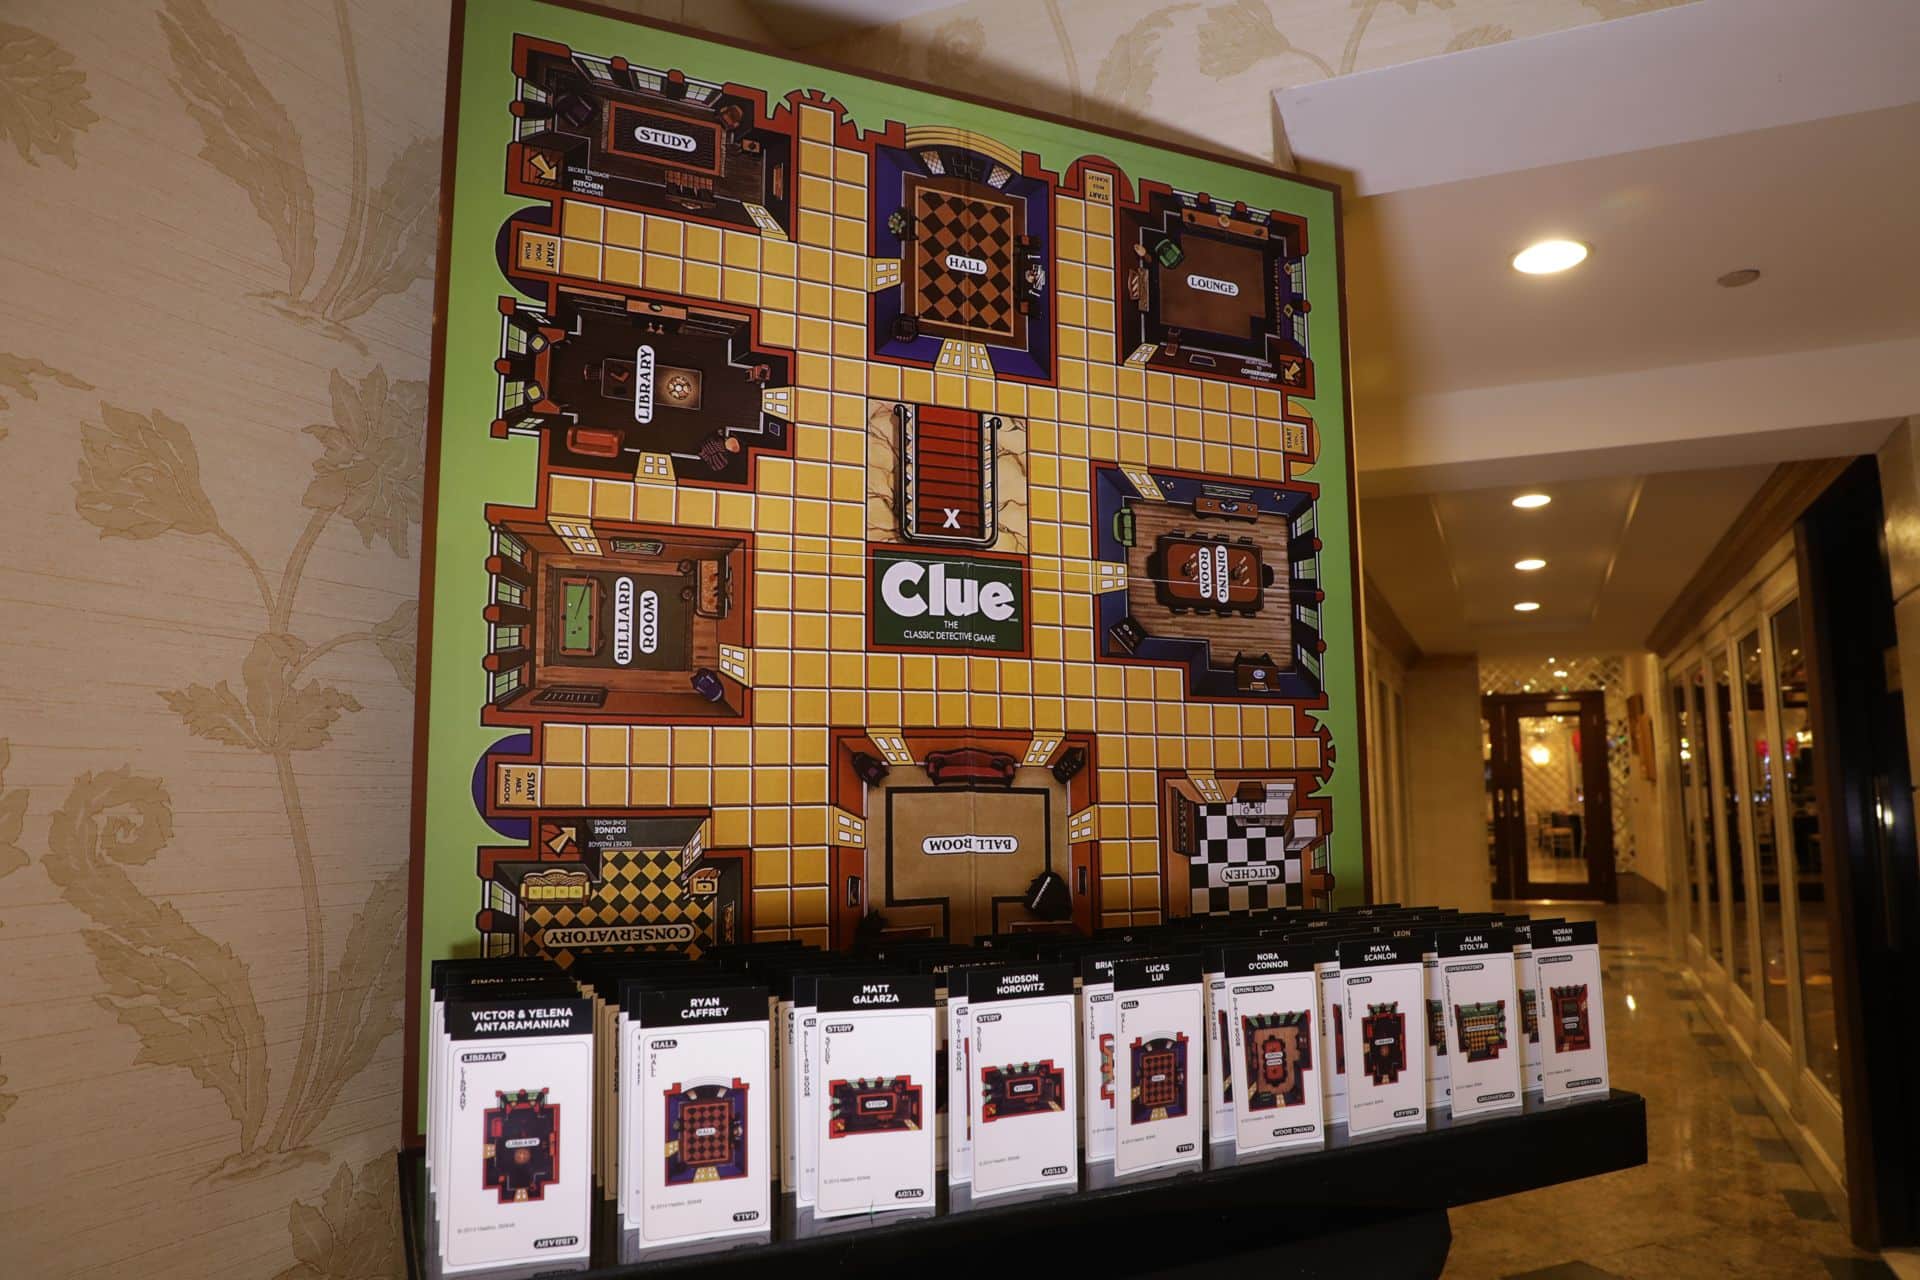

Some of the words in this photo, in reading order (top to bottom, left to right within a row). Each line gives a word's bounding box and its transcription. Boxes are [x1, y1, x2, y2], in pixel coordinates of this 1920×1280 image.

[639, 129, 693, 150] STUDY
[567, 166, 587, 174] SECRET
[572, 179, 604, 191] KITCHEN
[1089, 192, 1109, 201] START
[524, 241, 532, 260] PLUM
[535, 243, 543, 262] PROF.
[546, 241, 556, 269] START
[949, 256, 985, 274] HALL
[1190, 276, 1237, 296] LOUNGE
[638, 349, 654, 421] LIBRARY
[943, 508, 961, 529] X
[1200, 551, 1210, 594] ROOM
[1217, 550, 1227, 598] DINING
[881, 561, 1016, 621] Clue
[617, 579, 633, 661] BILLIARD
[642, 595, 657, 651] ROOM
[943, 620, 959, 629] THE
[903, 630, 935, 640] CLASSIC
[936, 631, 973, 641] DETECTIVE
[973, 634, 996, 643] GAME
[503, 768, 511, 804] PEACOCK
[526, 772, 536, 802] START
[594, 826, 627, 834] LOUNGE
[612, 840, 632, 848] SECRET
[928, 838, 973, 851] ROOM
[977, 837, 1012, 850] BALL
[1223, 866, 1278, 882] KITCHEN
[548, 926, 691, 944] CONSERVATORY
[1552, 928, 1573, 936] NORAH
[1464, 935, 1483, 943] ALAN
[1370, 944, 1391, 953] MAYA
[1459, 942, 1489, 951] STOLYAR
[1257, 952, 1279, 961] NORA
[1364, 952, 1397, 962] SCANLON
[1145, 964, 1170, 974] LUCAS
[1248, 960, 1289, 970] O'CONNOR
[1002, 974, 1039, 985] HUDSON
[1151, 974, 1164, 982] LUI
[862, 984, 890, 994] MATT
[996, 983, 1045, 995] HOROWITZ
[690, 997, 720, 1008] RYAN
[852, 993, 900, 1005] GALARZA
[471, 1009, 516, 1022] VICTOR
[517, 1009, 526, 1019] &
[528, 1007, 573, 1019] YELENA
[681, 1007, 729, 1019] CAFFREY
[978, 1014, 1001, 1023] STUDY
[474, 1018, 571, 1033] ANTARAMANIAN
[827, 1024, 853, 1033] STUDY
[652, 1040, 676, 1049] HALL
[463, 1052, 504, 1063] LIBRARY
[1043, 1166, 1067, 1176] STUDY
[896, 1189, 923, 1199] STUDY
[735, 1211, 758, 1222] HALL
[535, 1236, 577, 1249] LIBRARY
